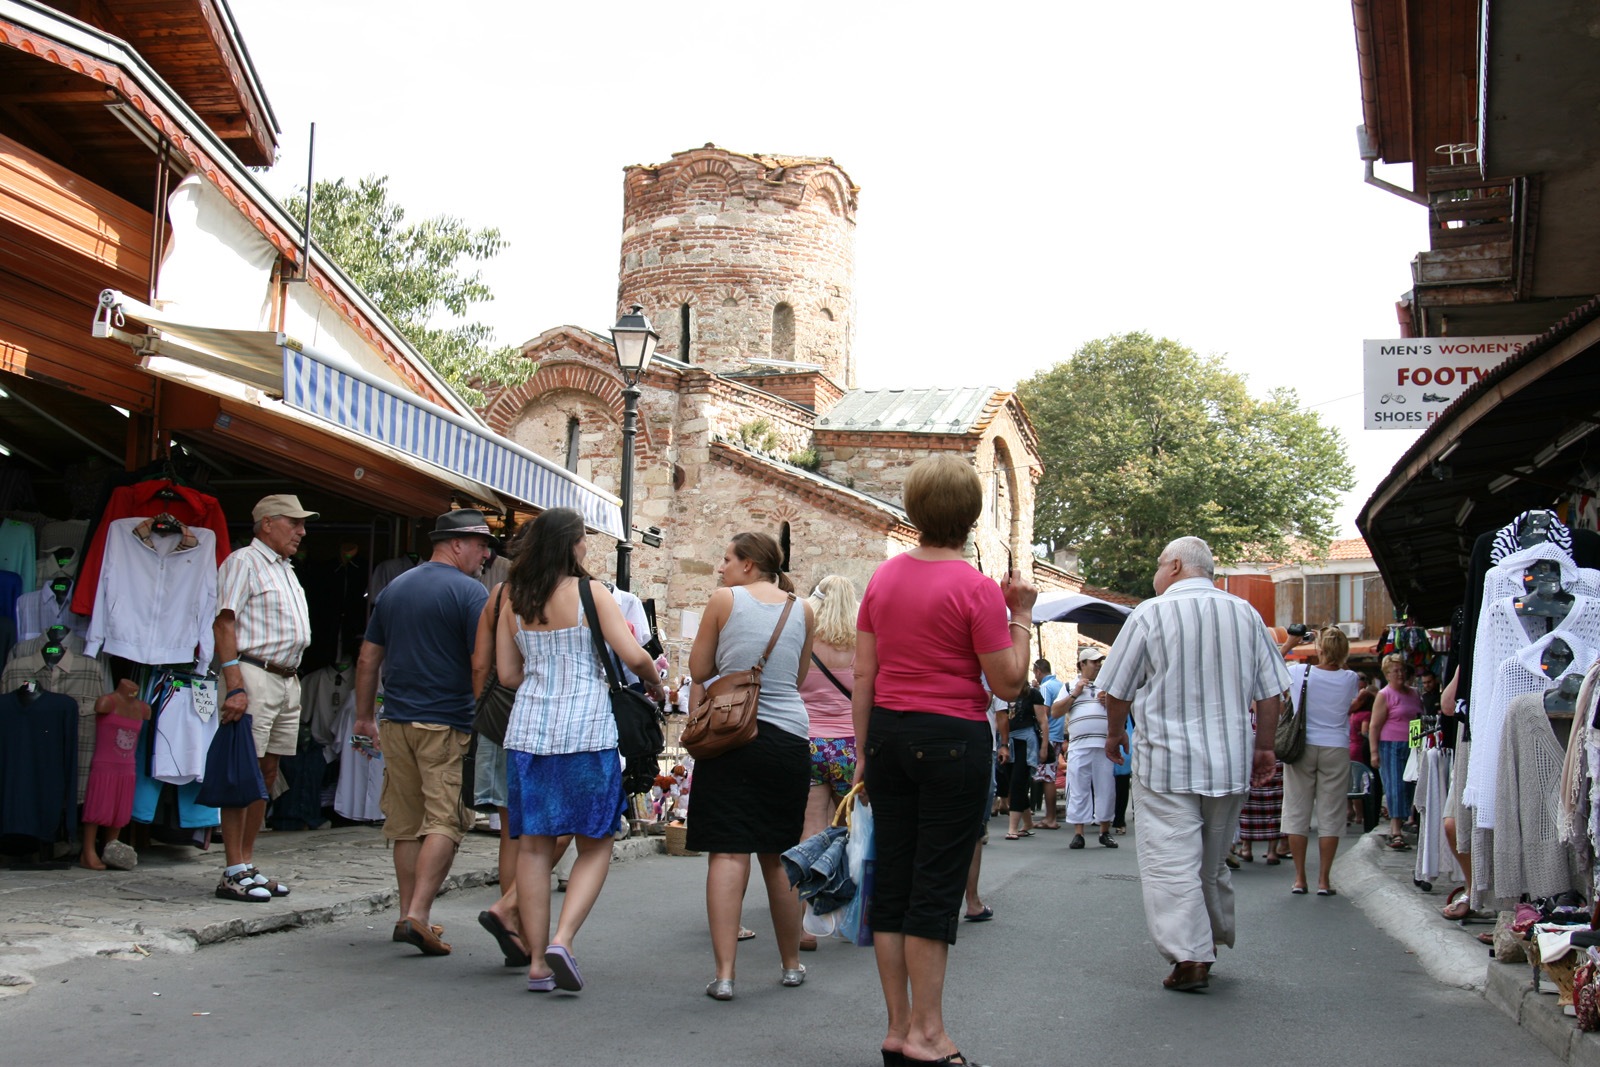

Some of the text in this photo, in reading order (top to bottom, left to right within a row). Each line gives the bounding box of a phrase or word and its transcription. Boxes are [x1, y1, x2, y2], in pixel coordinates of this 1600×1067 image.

[1381, 343, 1522, 355] MEN'S WOMEN'S
[1374, 412, 1422, 421] SHOES
